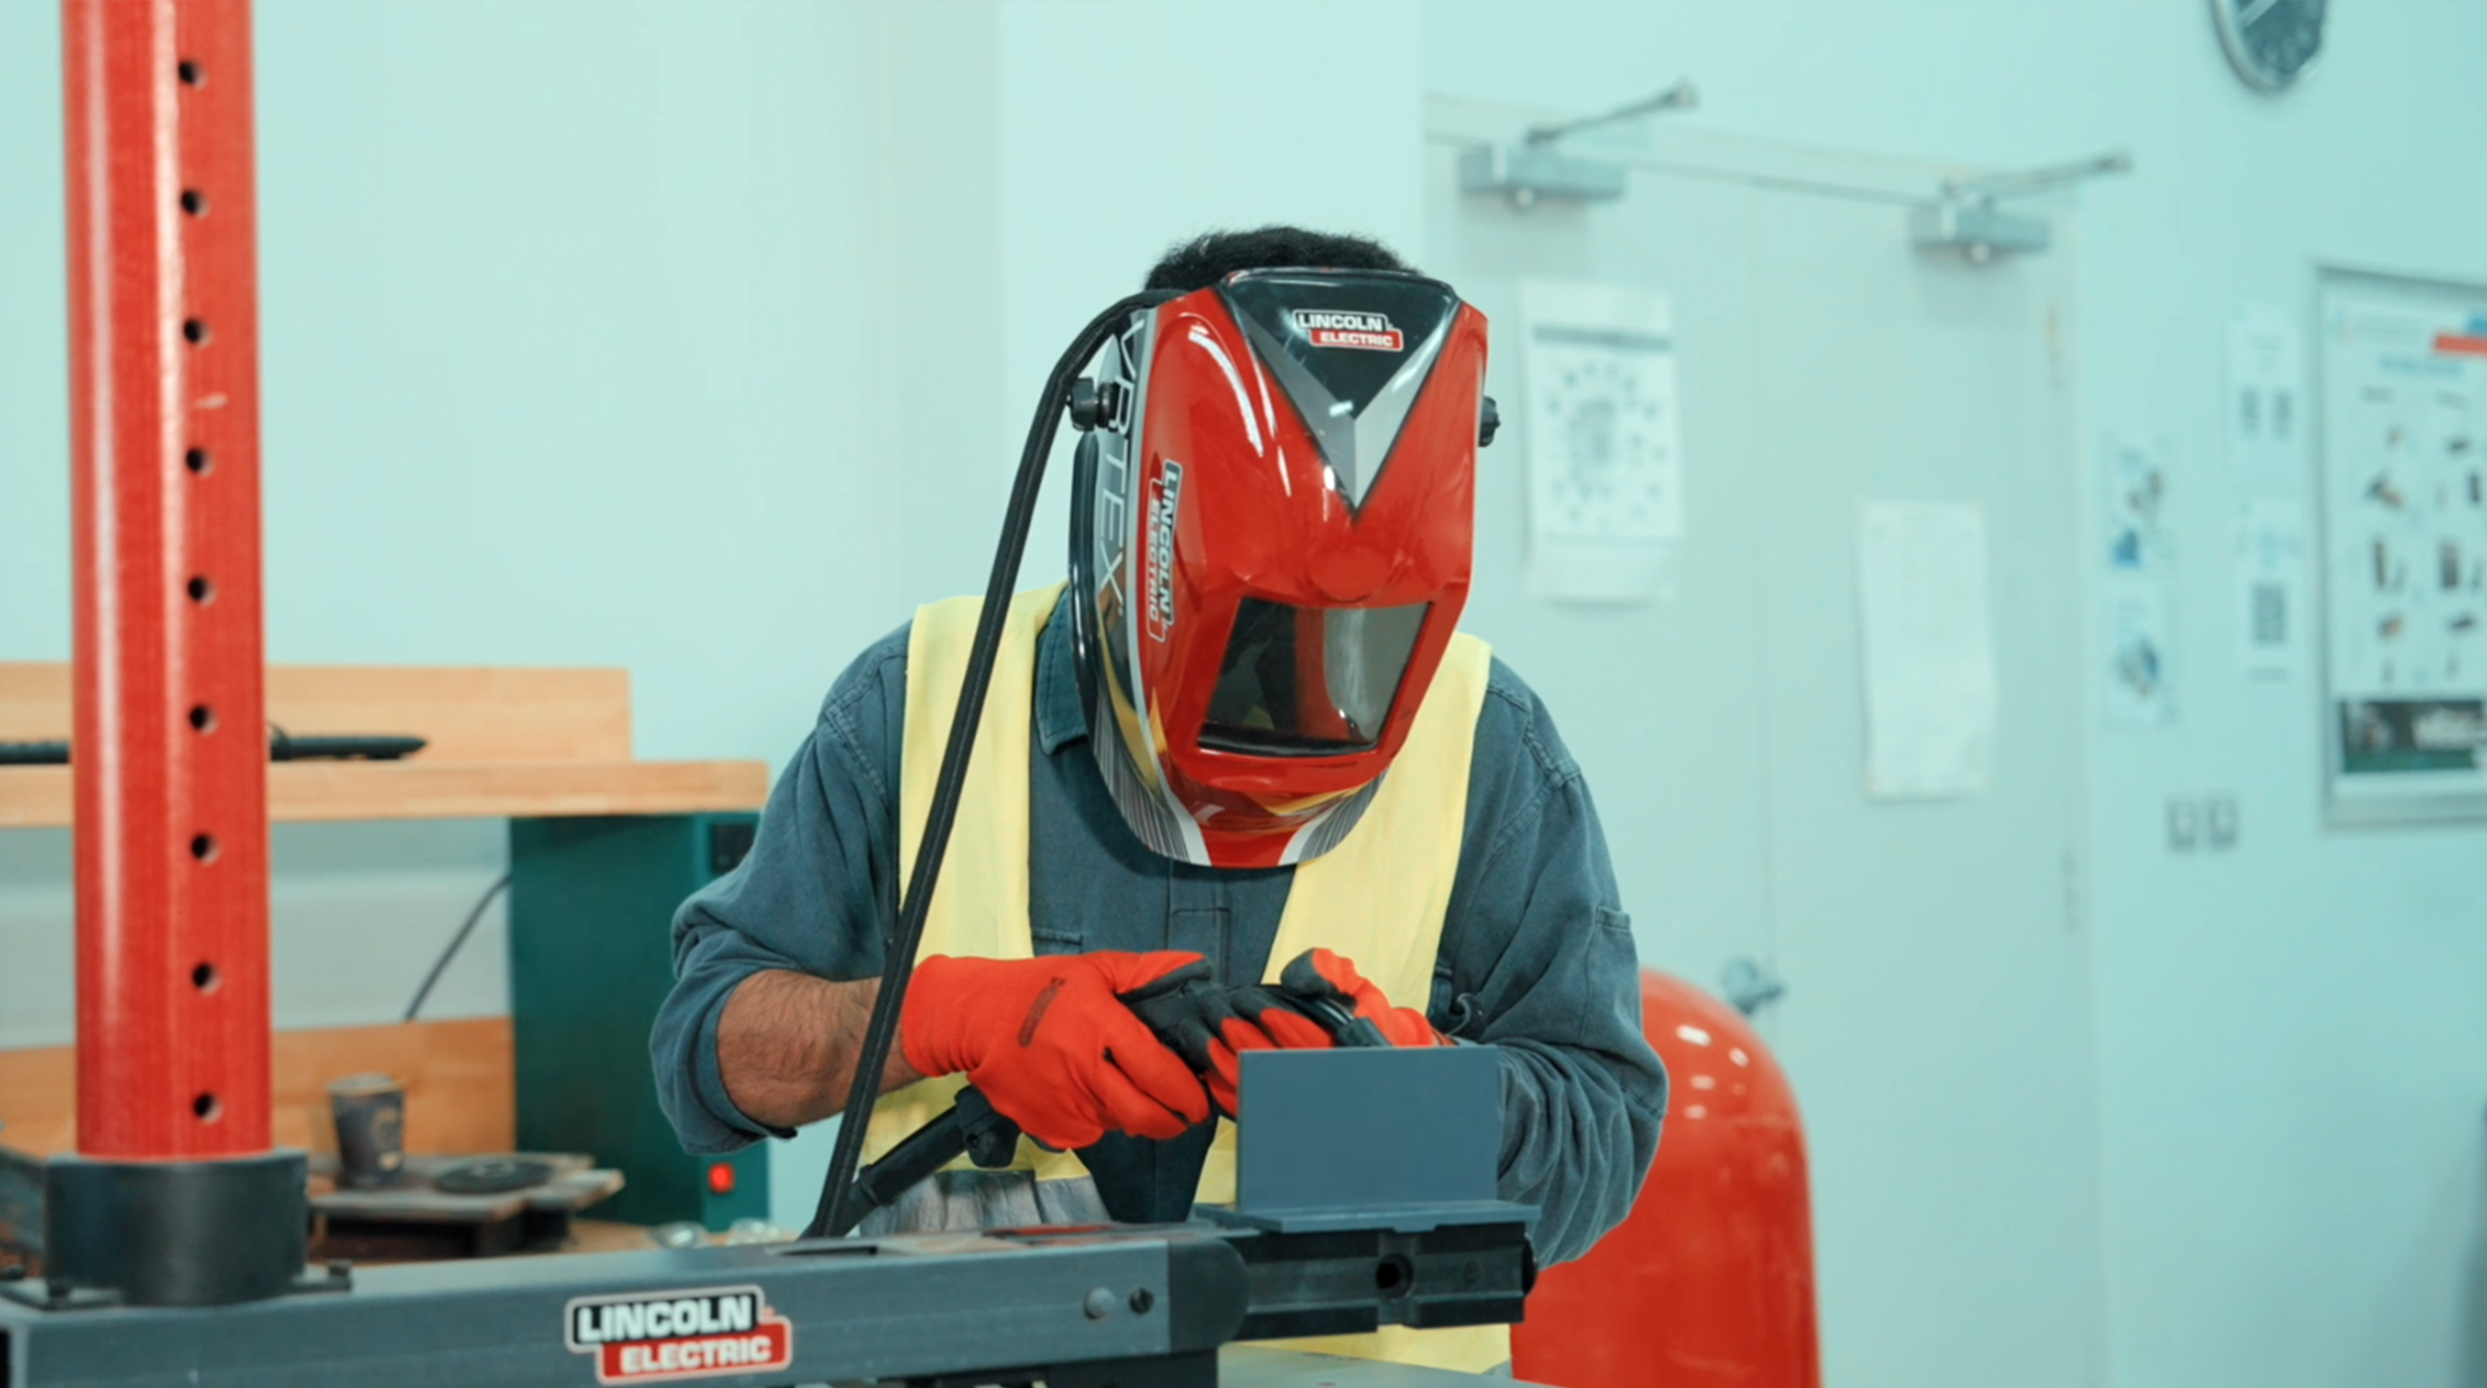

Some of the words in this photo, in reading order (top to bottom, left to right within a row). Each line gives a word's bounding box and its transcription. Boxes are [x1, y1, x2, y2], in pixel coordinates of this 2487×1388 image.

[1300, 314, 1383, 332] LINCOLN
[1320, 332, 1393, 346] ELECTRIC
[1149, 497, 1160, 622] ELECTRIC
[1159, 470, 1178, 615] LINCOLN
[577, 1295, 752, 1343] LINCOLN
[620, 1335, 773, 1374] ELECTRIC
